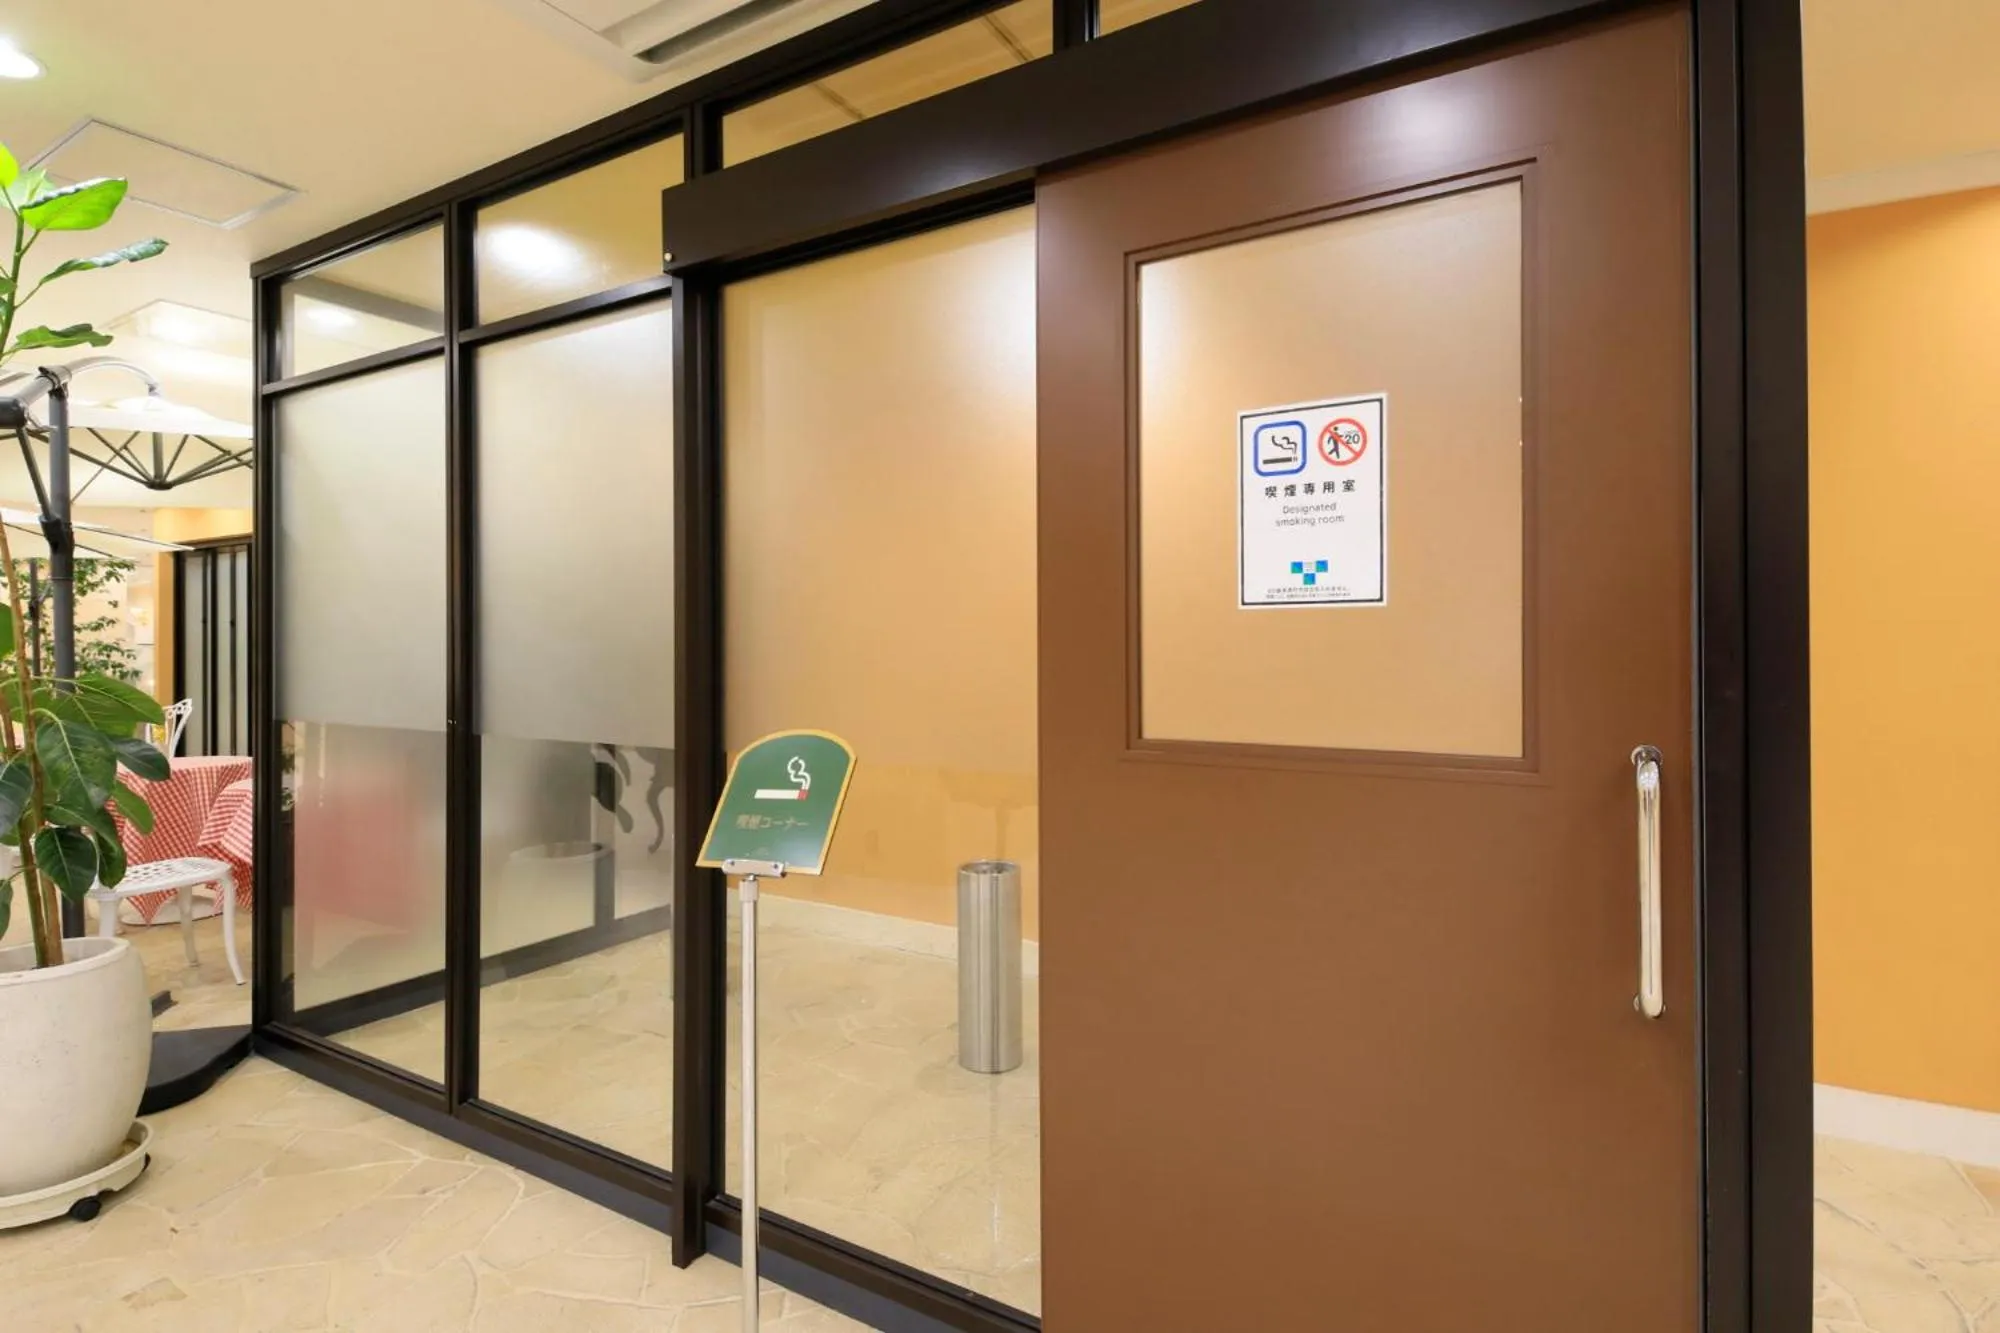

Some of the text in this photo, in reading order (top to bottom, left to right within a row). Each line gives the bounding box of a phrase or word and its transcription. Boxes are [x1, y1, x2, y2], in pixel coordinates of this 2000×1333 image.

[1345, 433, 1360, 444] 20
[1265, 479, 1356, 498] 喫煙専用室
[1283, 502, 1337, 514] Designated
[1275, 515, 1344, 527] smoking room
